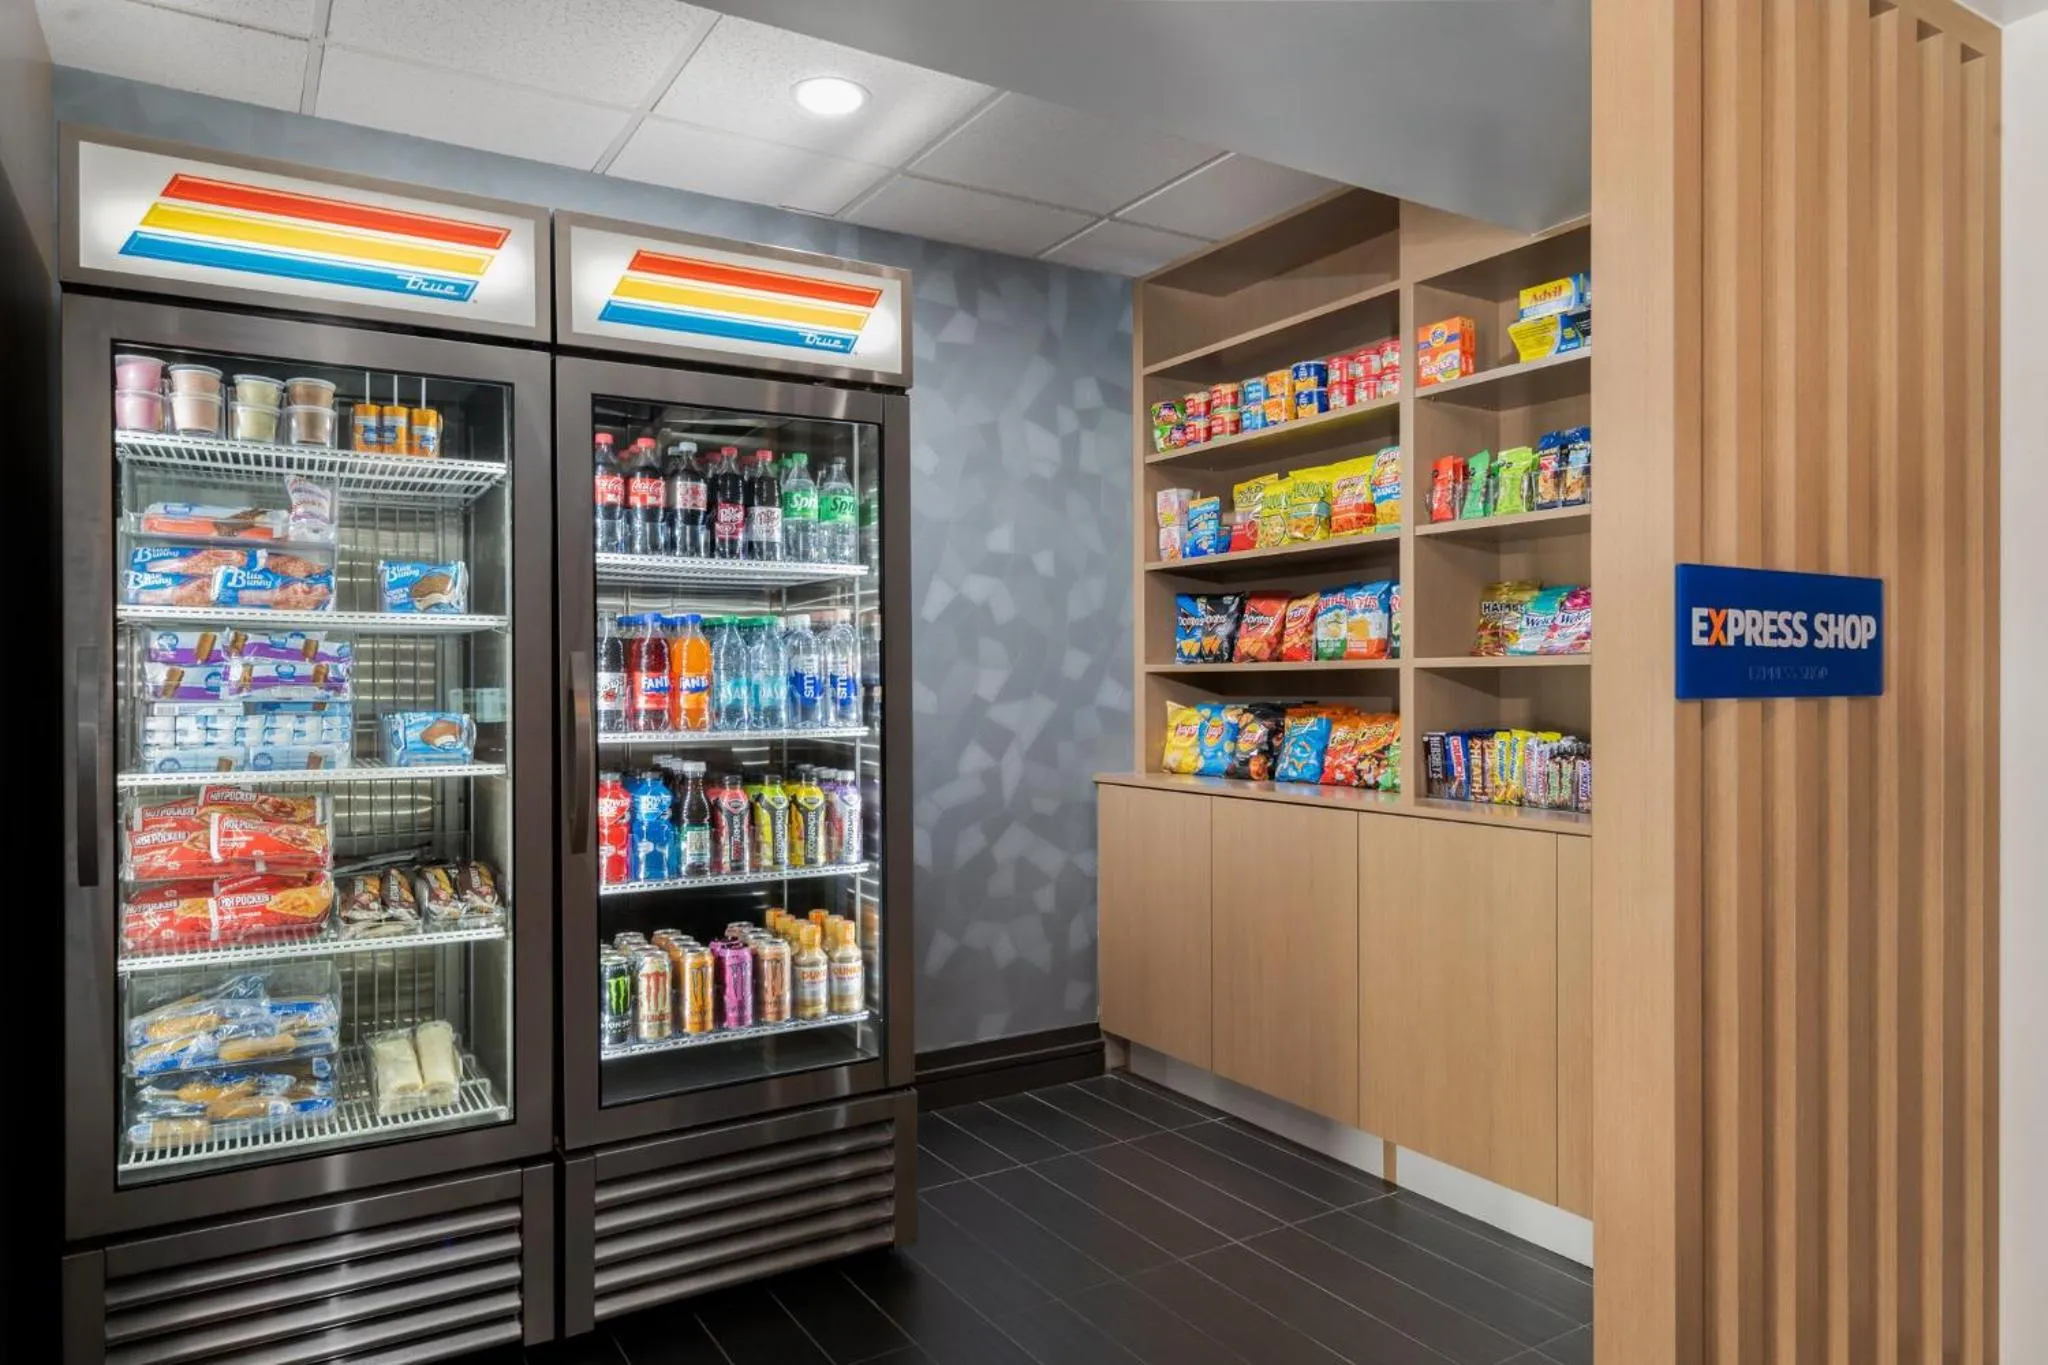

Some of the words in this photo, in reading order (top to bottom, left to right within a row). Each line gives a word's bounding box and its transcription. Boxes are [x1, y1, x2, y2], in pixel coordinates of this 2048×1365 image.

[1528, 284, 1563, 304] Advil
[1691, 607, 1808, 648] EXPRESS
[1813, 613, 1877, 649] SHOP
[1471, 748, 1483, 793] HEATH
[776, 810, 785, 858] BODYARMOR
